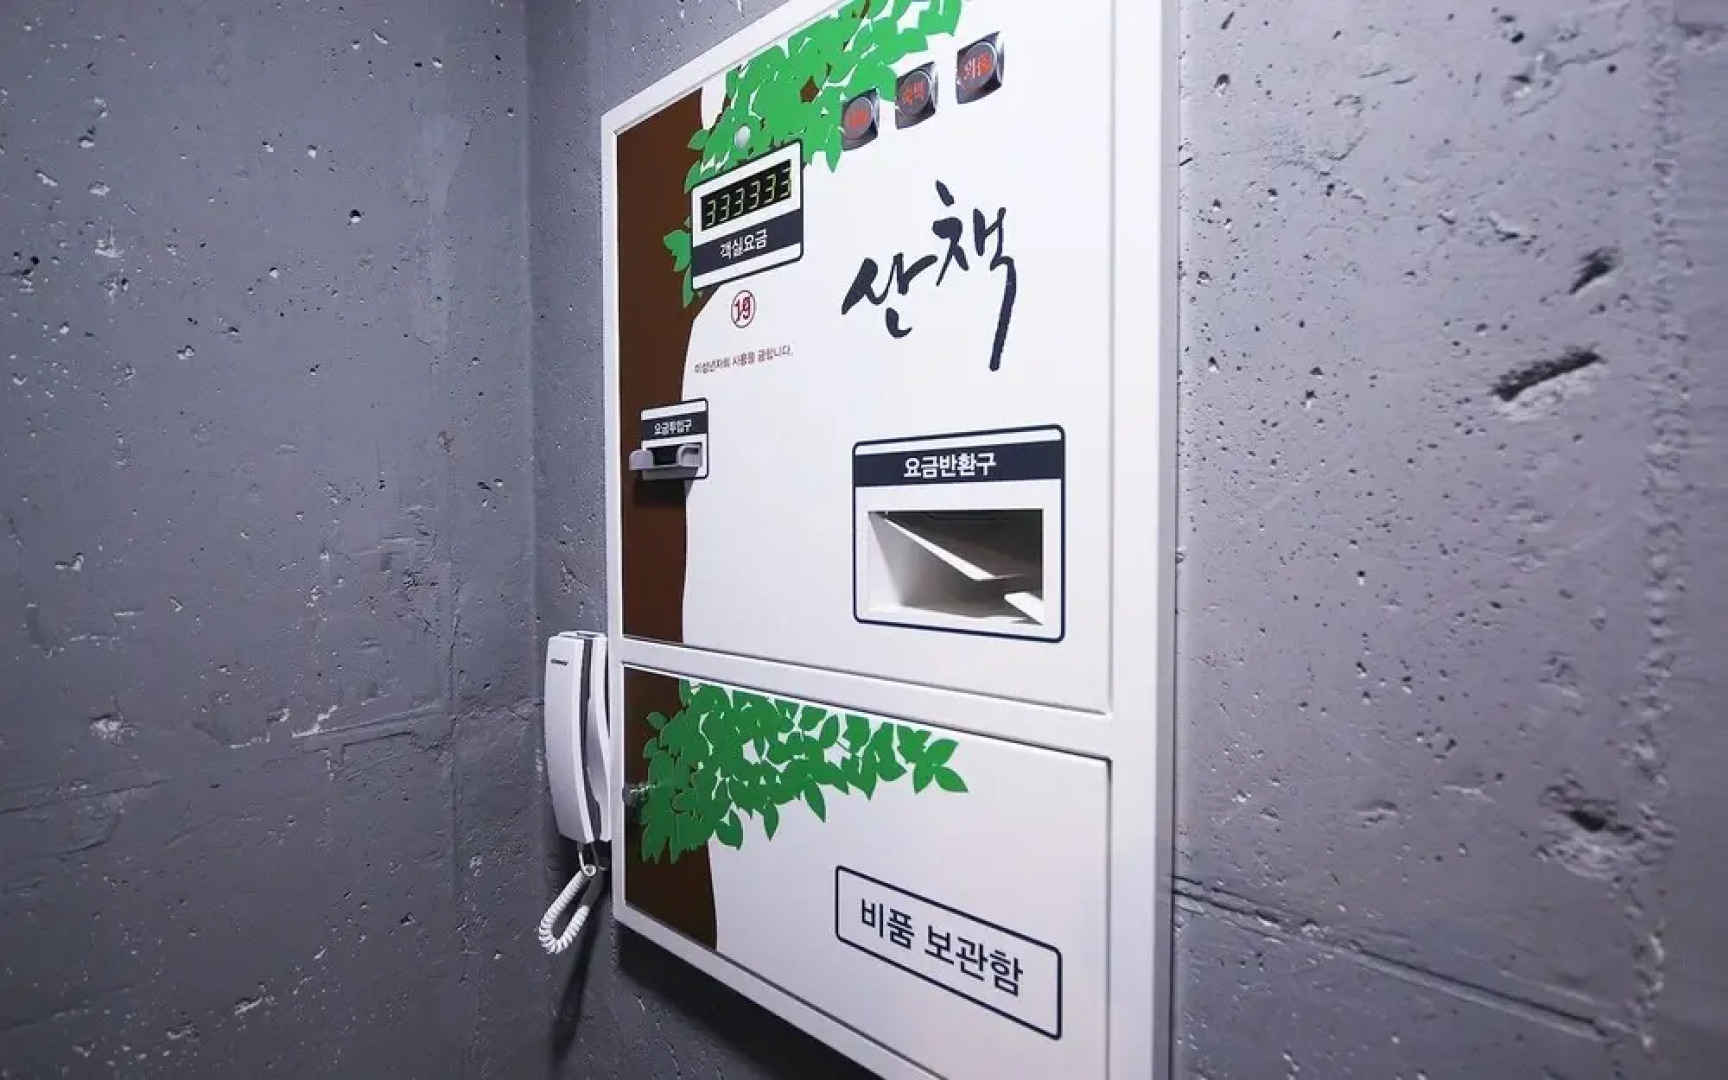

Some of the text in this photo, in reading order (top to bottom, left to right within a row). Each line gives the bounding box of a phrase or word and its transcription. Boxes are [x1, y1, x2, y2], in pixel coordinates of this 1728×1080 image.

[720, 228, 768, 259] 객실요금
[734, 296, 751, 321] 19
[903, 452, 998, 479] 요금반환구
[861, 898, 1024, 997] 비품 보관함
